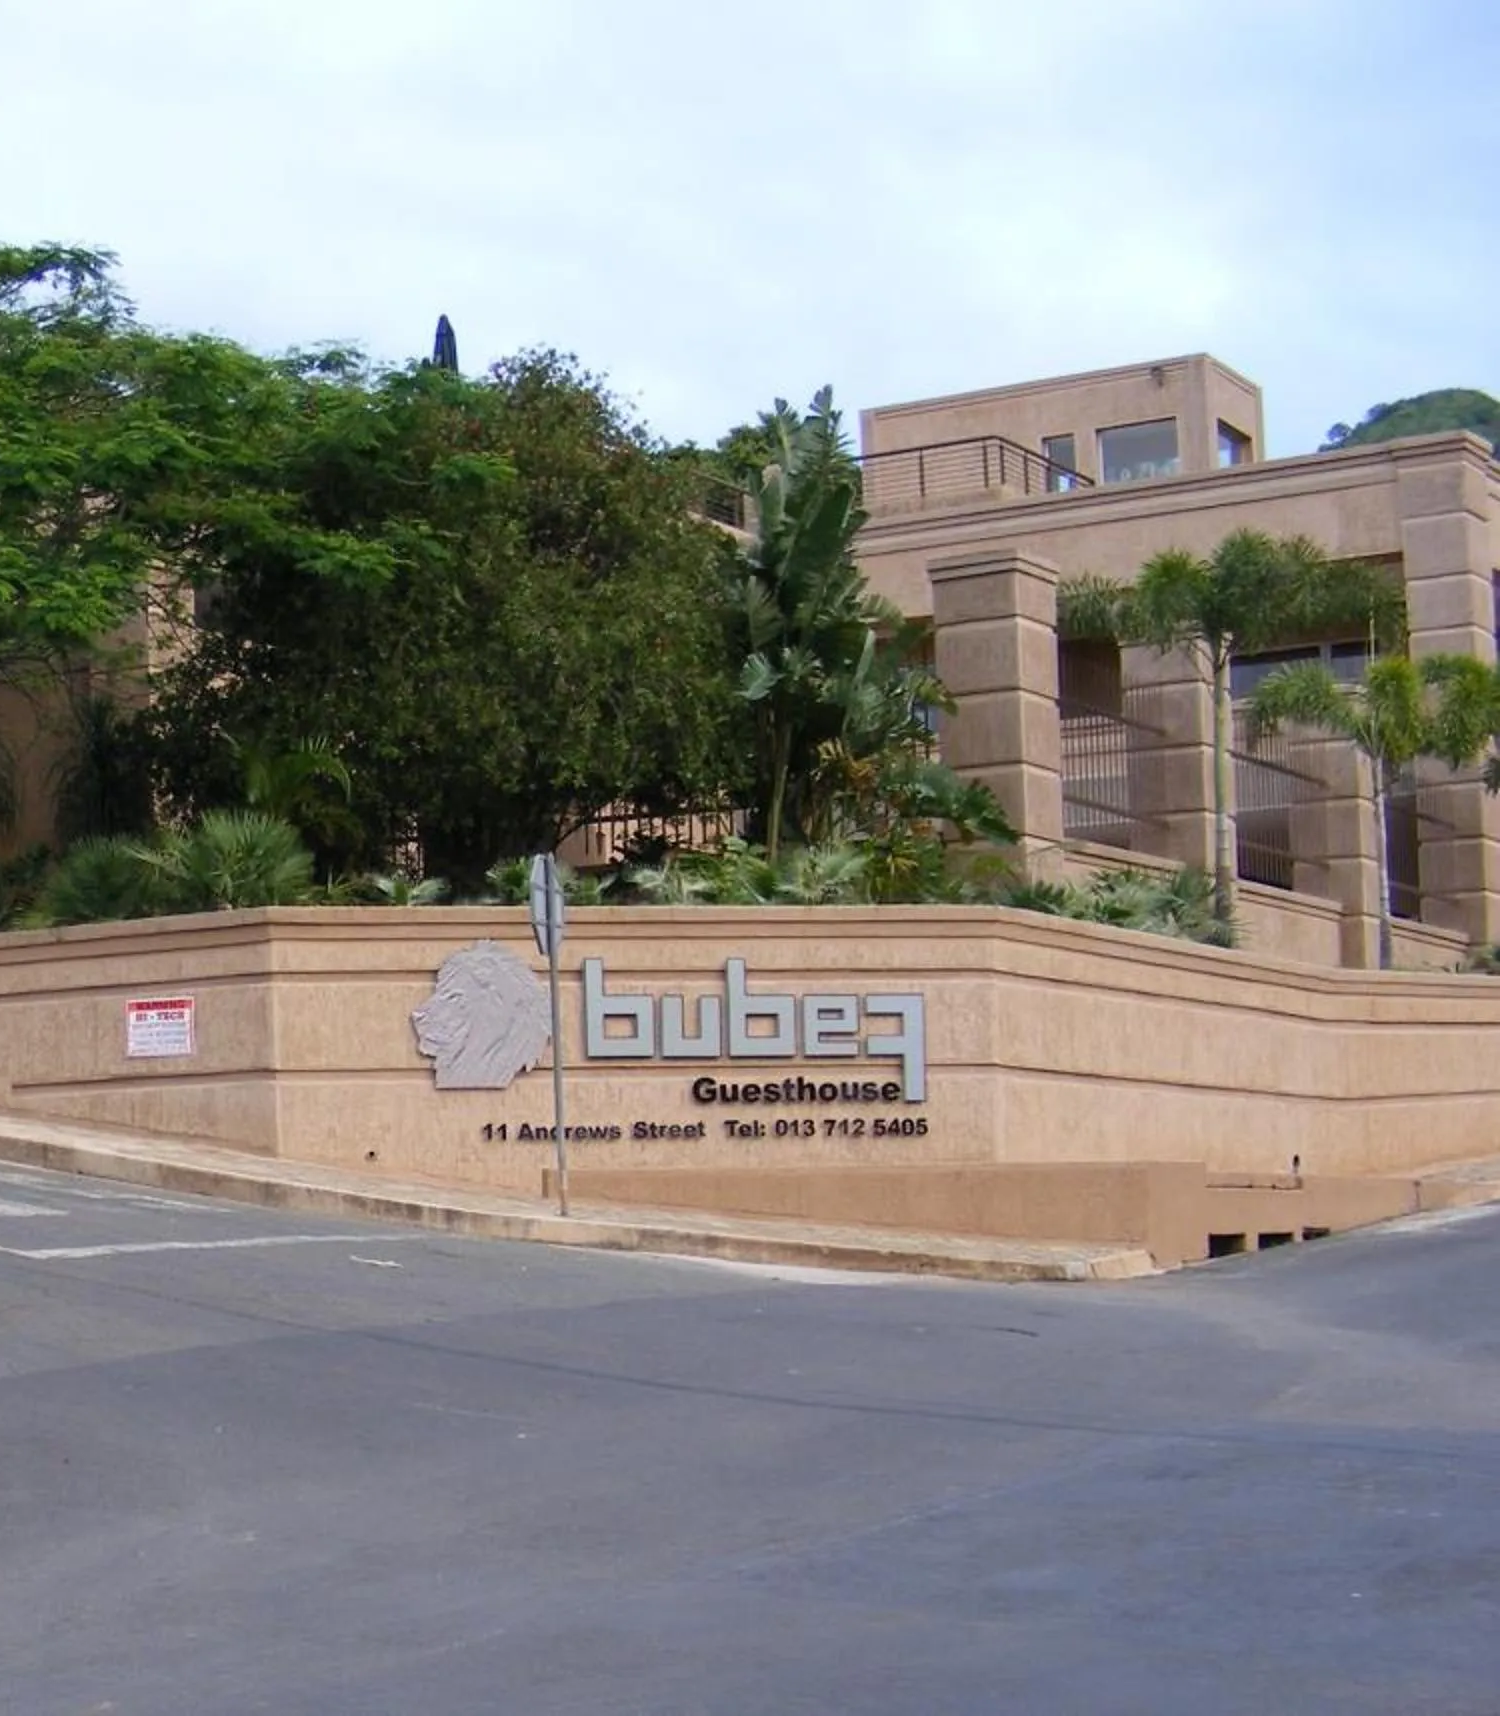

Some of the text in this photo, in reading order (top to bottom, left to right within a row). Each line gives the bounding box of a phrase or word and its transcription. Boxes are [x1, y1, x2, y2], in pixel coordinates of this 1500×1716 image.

[691, 1076, 901, 1102] Guesthouse
[482, 1122, 508, 1141] 11
[631, 1120, 707, 1140] Street
[723, 1118, 766, 1138] Tel:
[774, 1118, 816, 1138] 013
[823, 1118, 866, 1137] 712
[872, 1117, 929, 1137] 5405
